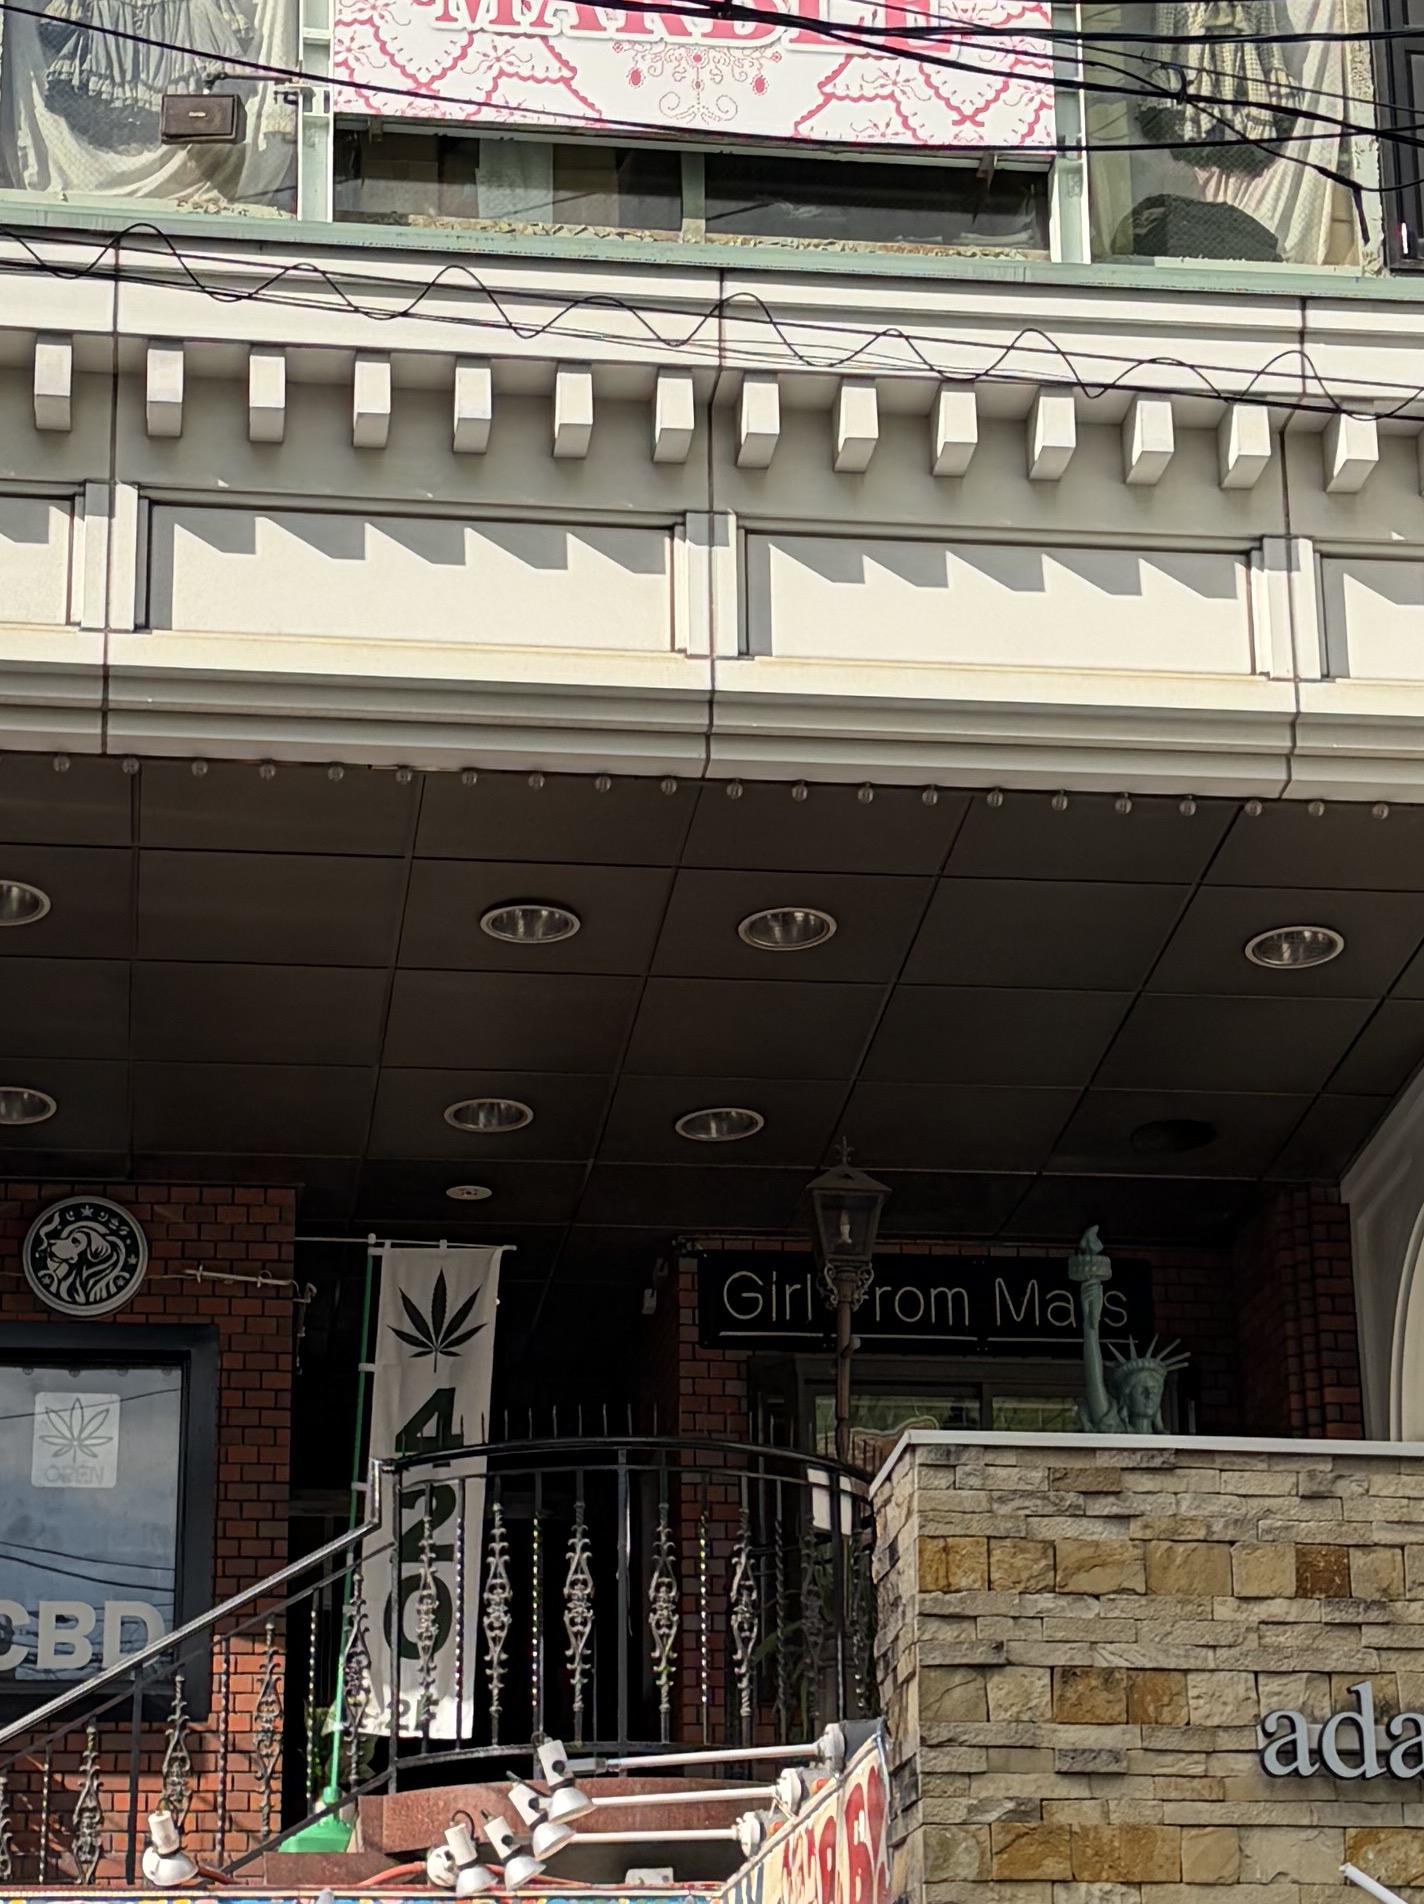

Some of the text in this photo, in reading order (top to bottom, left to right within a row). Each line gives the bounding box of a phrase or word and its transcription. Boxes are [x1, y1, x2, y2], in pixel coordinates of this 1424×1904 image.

[722, 1270, 1128, 1328] Girl rom Mas
